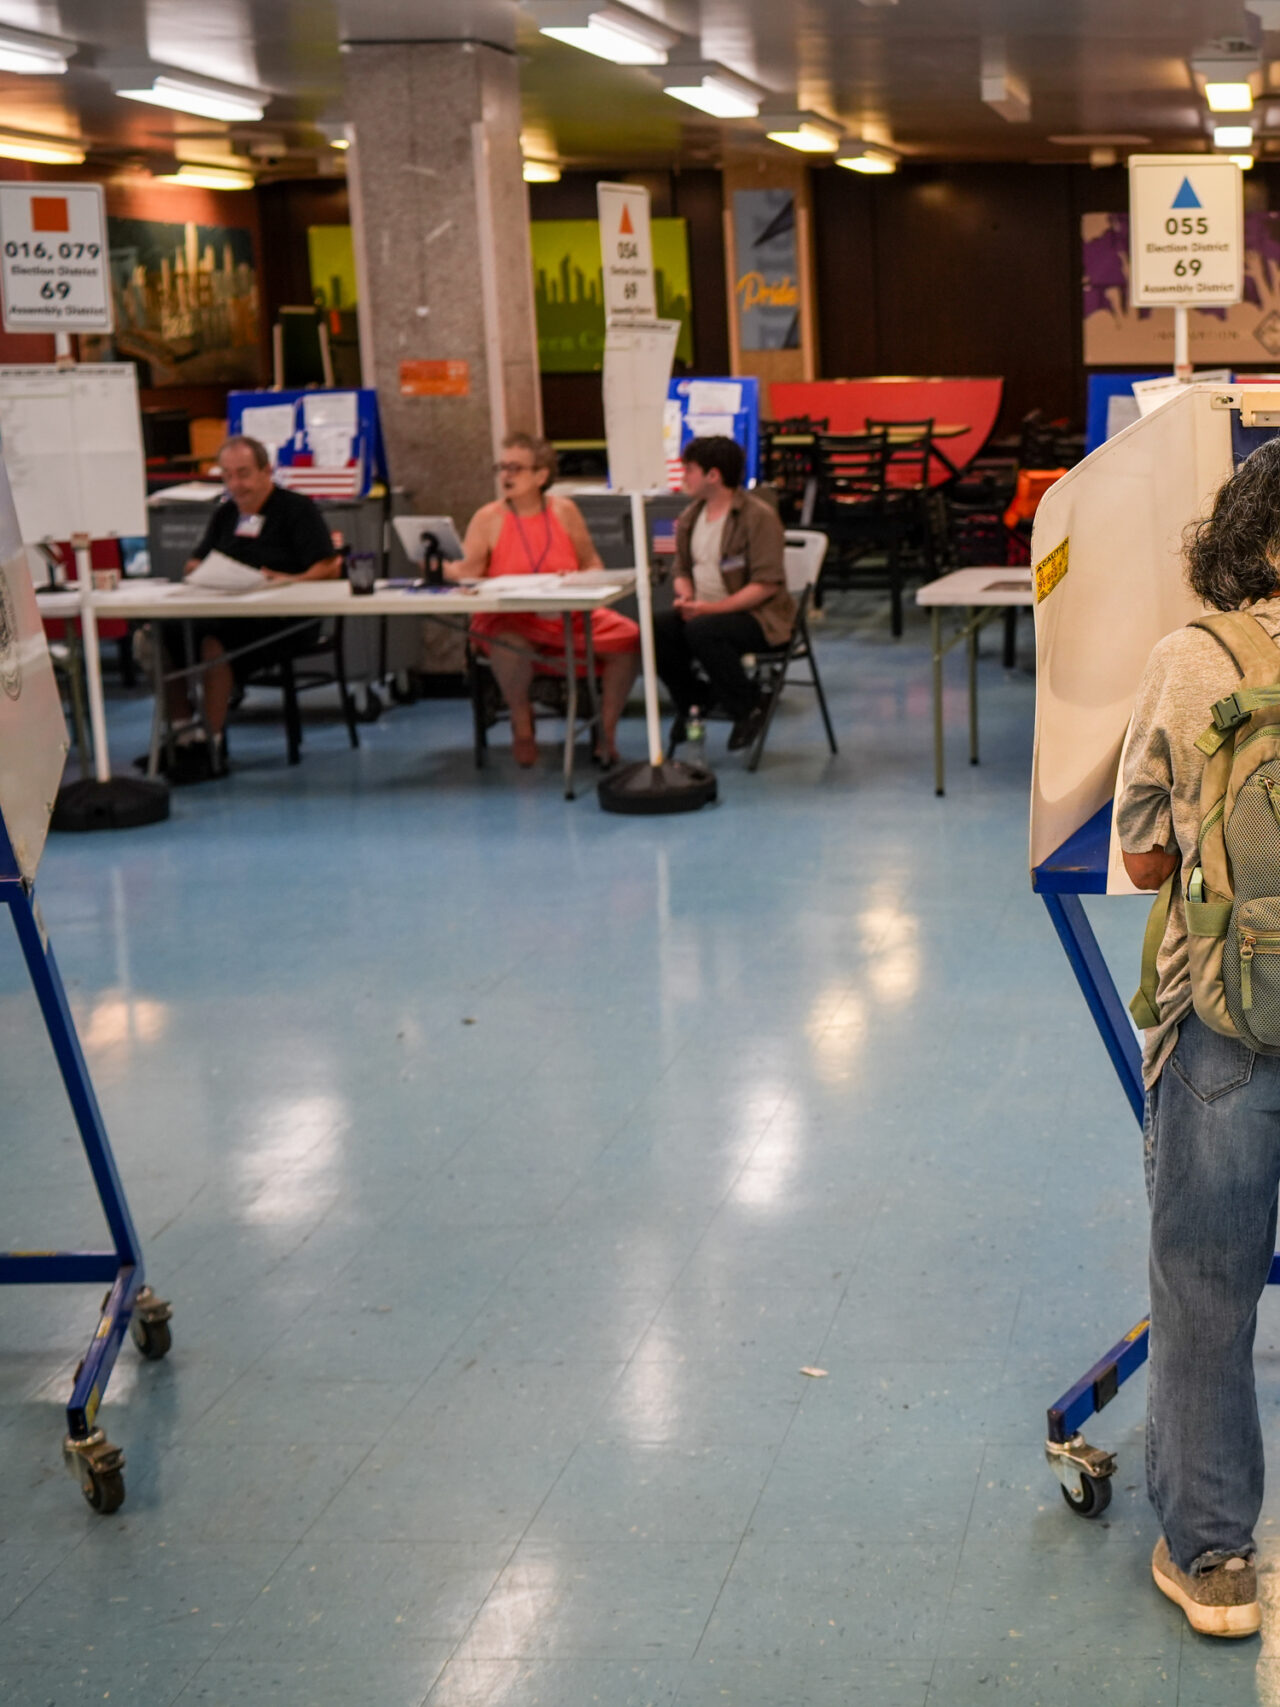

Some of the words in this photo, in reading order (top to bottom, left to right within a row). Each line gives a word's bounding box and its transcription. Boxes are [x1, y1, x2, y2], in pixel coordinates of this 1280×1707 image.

[1165, 217, 1208, 235] 055
[1174, 259, 1202, 276] 69
[40, 281, 71, 300] 69
